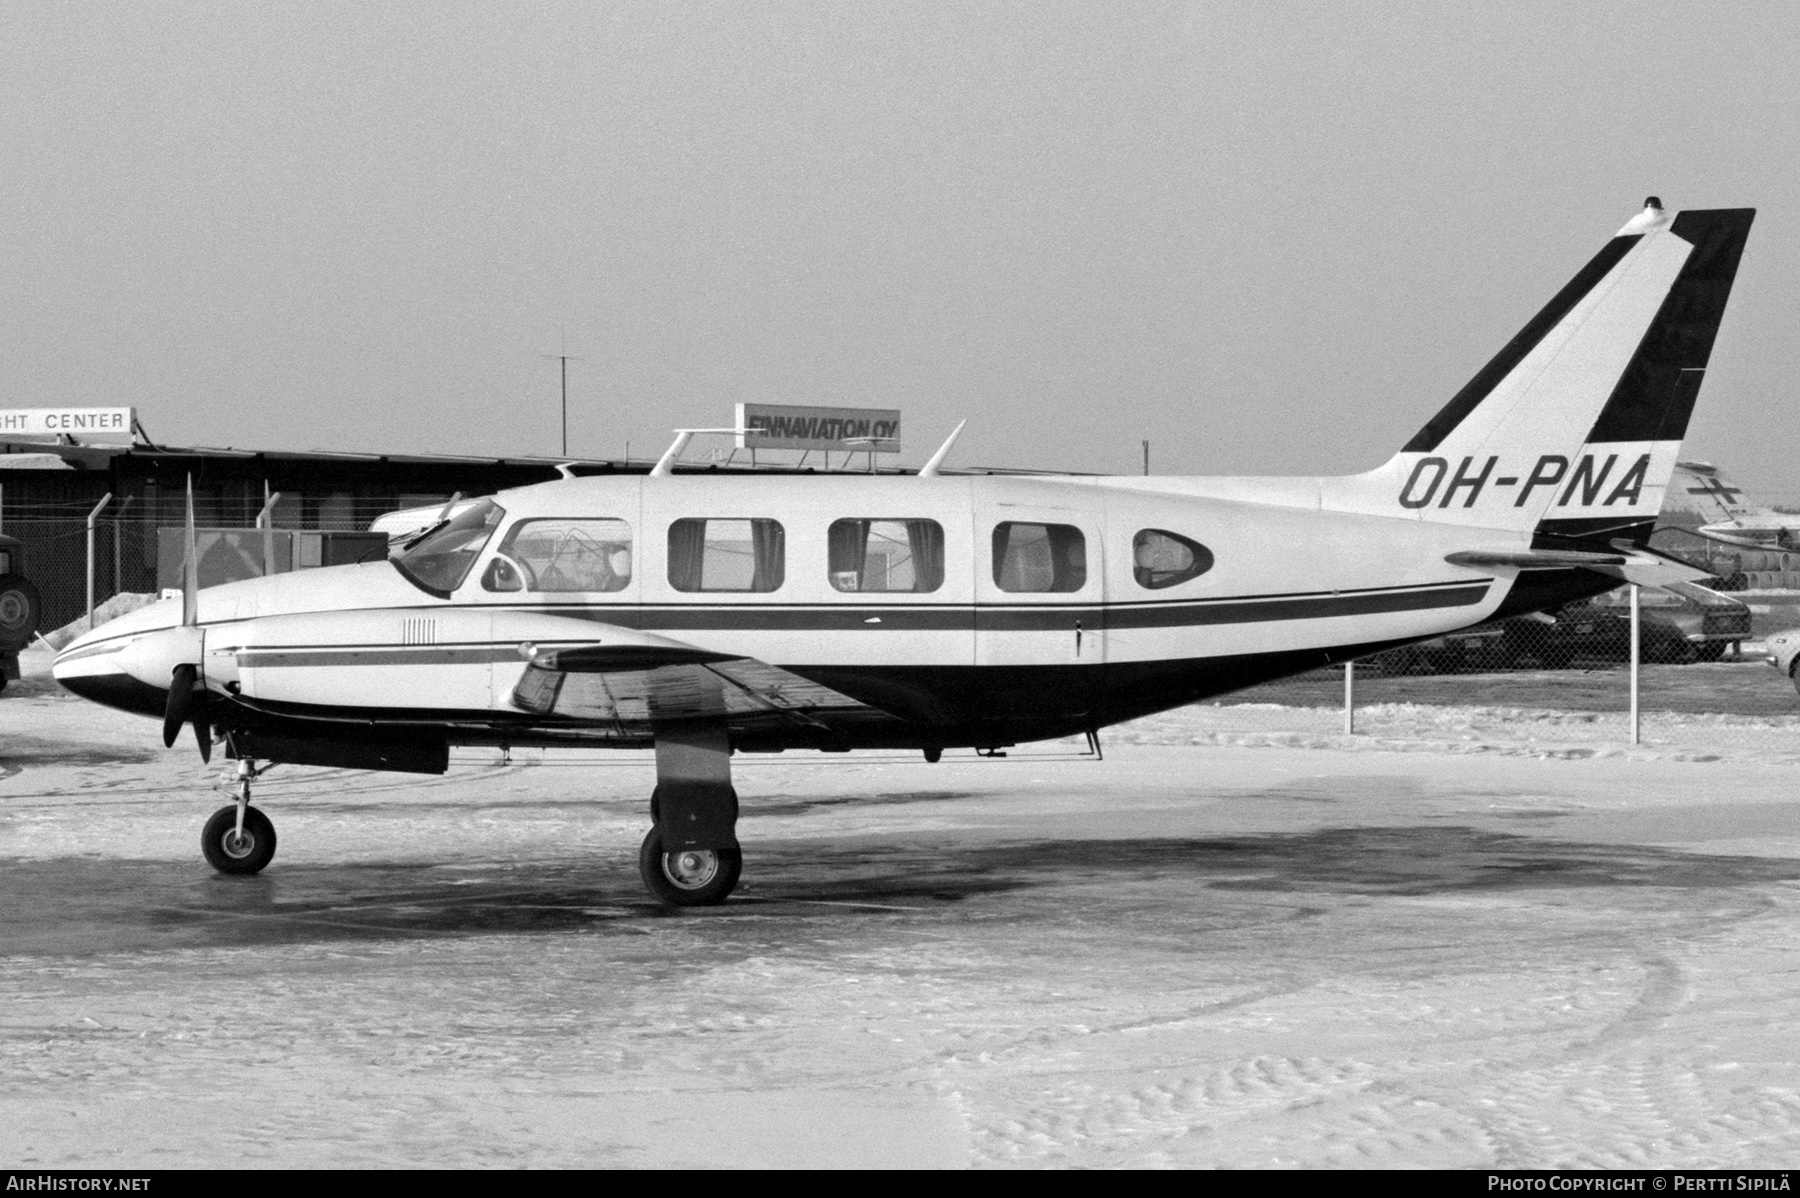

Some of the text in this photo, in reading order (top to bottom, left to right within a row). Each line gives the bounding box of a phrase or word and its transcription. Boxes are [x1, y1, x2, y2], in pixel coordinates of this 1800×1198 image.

[0, 413, 123, 429] HT CENTER
[748, 415, 898, 440] FINNAVIATION OY
[1399, 453, 1651, 509] OH-PNA
